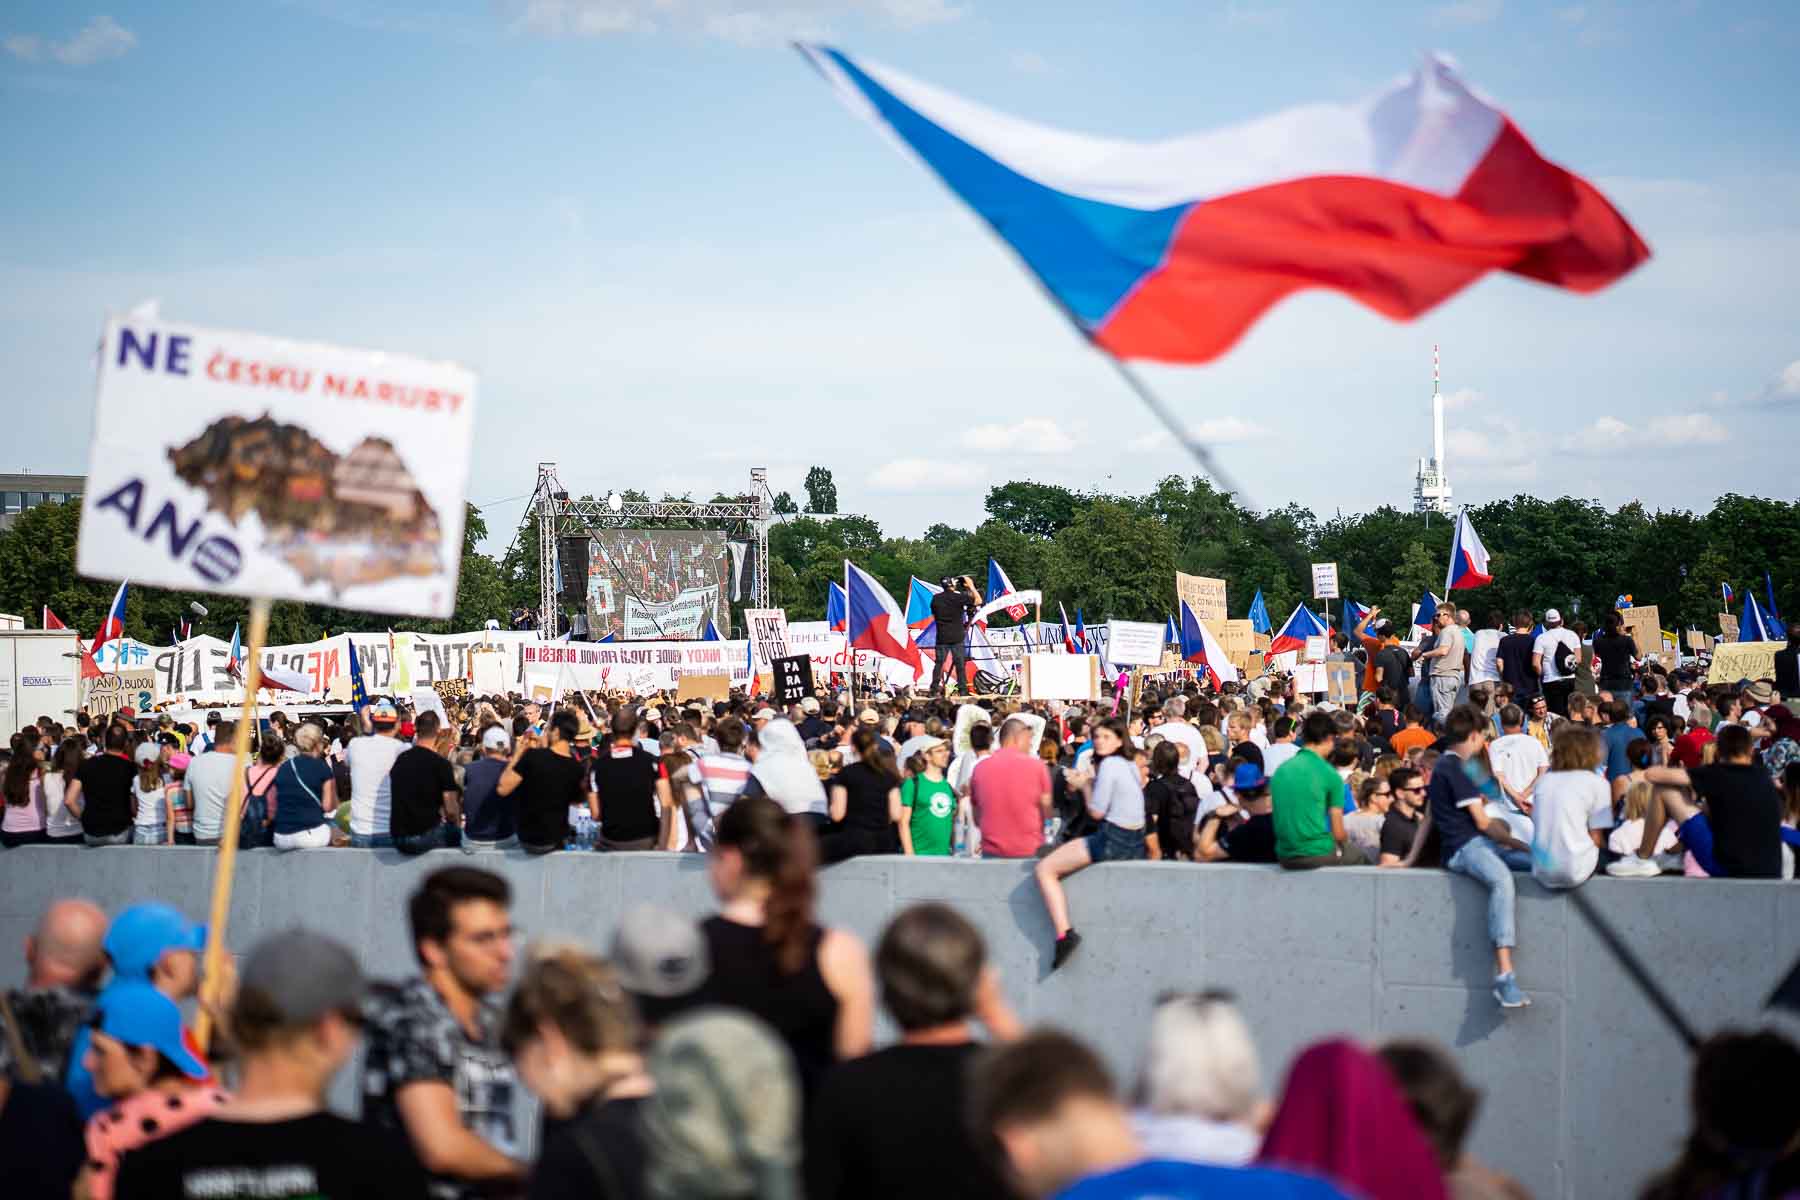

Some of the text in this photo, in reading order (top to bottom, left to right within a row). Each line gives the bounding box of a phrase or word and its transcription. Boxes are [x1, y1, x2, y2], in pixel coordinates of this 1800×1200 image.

[116, 327, 466, 414] NE ČESKU NARUBY
[96, 477, 242, 584] ANO
[755, 617, 783, 641] GAME
[783, 662, 800, 673] PA
[785, 675, 801, 686] RA
[784, 687, 804, 699] ZIT
